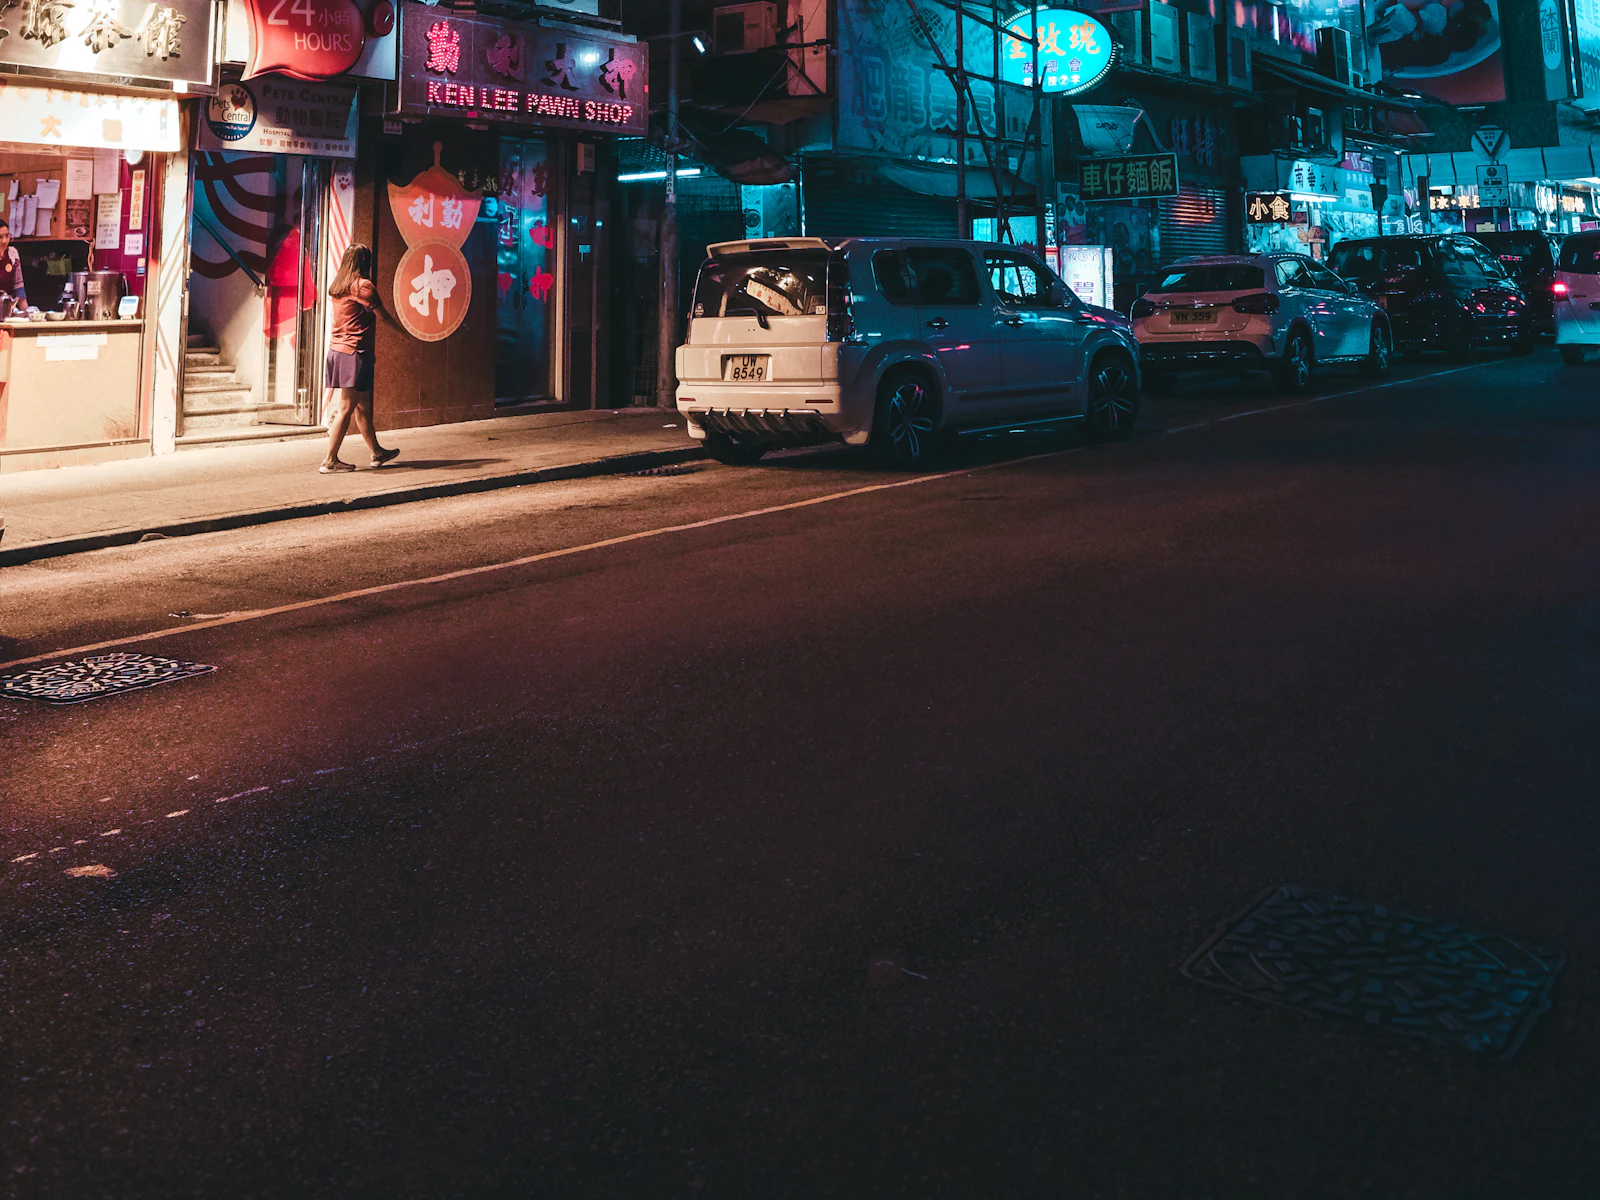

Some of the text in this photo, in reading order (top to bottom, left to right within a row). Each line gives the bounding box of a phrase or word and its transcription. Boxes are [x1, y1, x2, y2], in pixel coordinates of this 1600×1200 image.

[318, 8, 350, 29] 小時
[294, 32, 352, 52] HOURS
[212, 97, 231, 110] Pets
[427, 81, 633, 124] KEN LEE PAWN SHOP
[221, 108, 251, 123] Central
[275, 106, 341, 129] 動物醫院
[263, 128, 291, 137] HOSPITAL
[1082, 158, 1173, 196] 車仔麵飯
[1249, 194, 1291, 221] 小食
[409, 254, 457, 325] 押
[1175, 311, 1211, 321] VN 359
[733, 366, 764, 380] 8549
